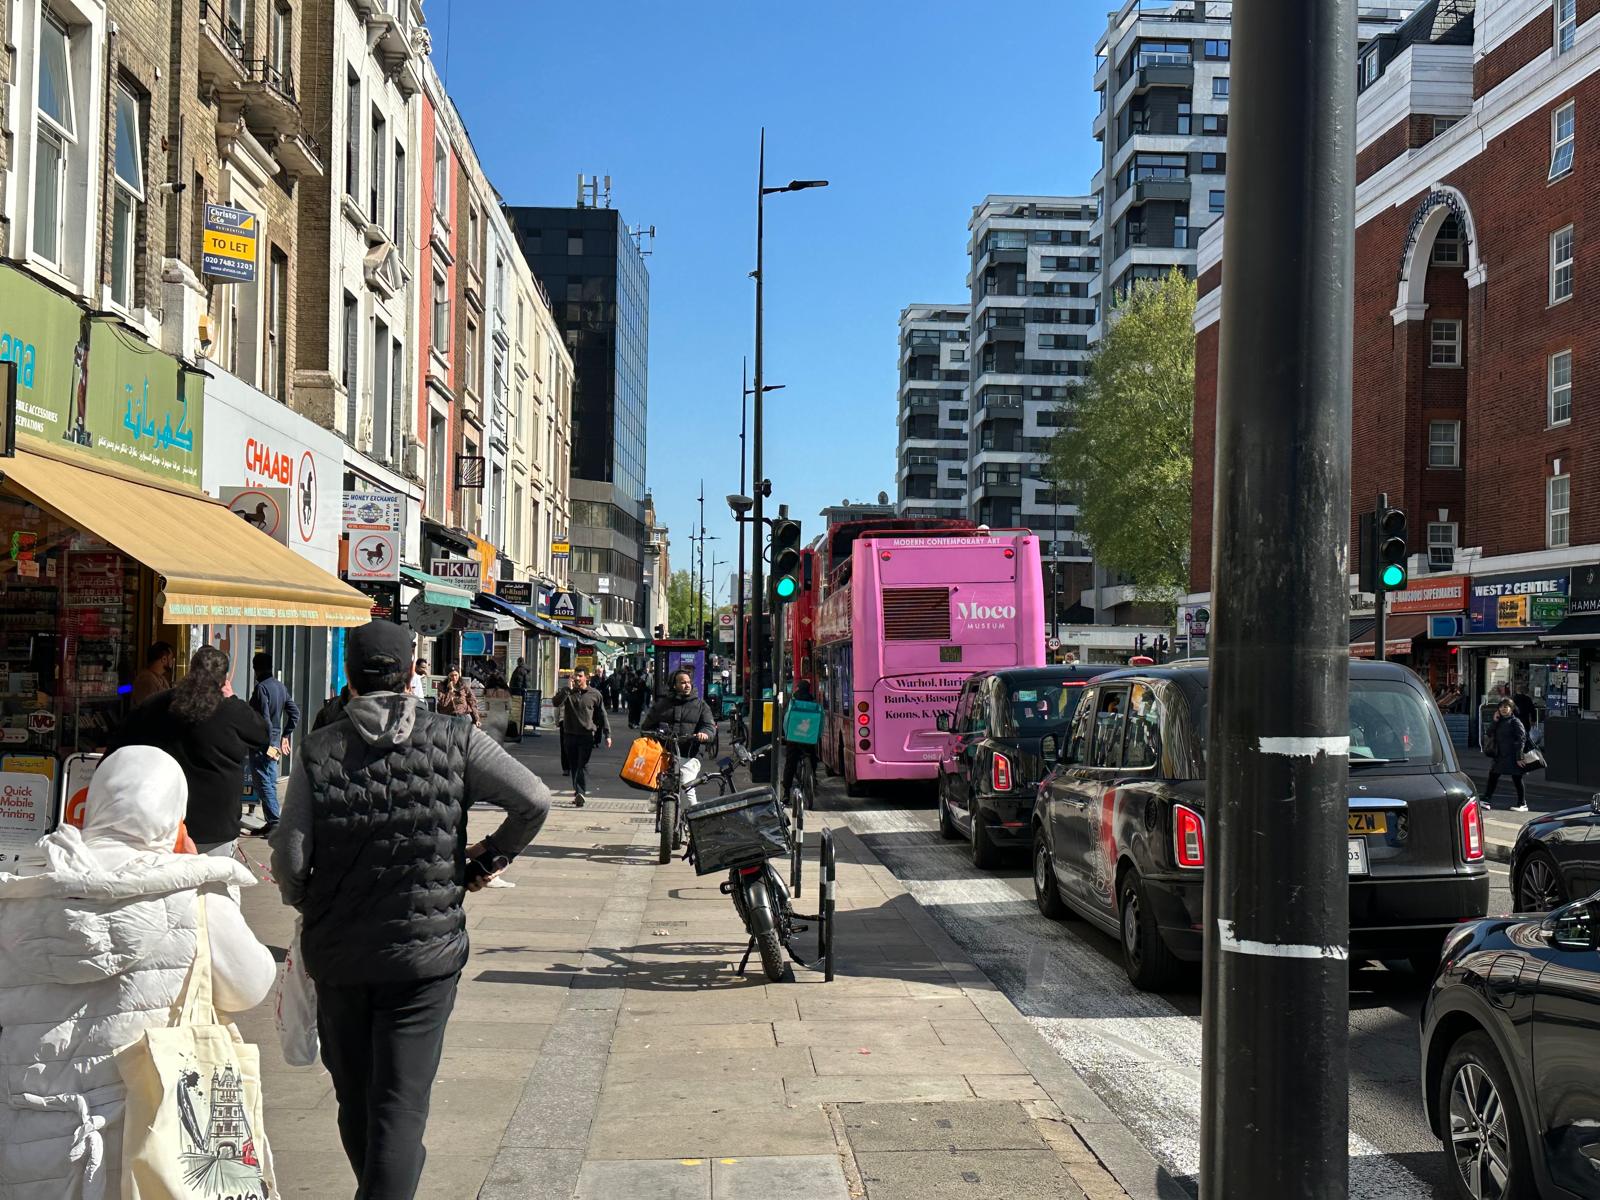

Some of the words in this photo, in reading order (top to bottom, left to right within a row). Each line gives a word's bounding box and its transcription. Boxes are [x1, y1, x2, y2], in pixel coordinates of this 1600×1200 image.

[210, 208, 237, 220] Christo
[212, 238, 226, 249] TO
[230, 241, 248, 253] LET
[205, 256, 218, 264] 020
[237, 262, 253, 271] 1203
[15, 414, 44, 432] SERVATIONS
[245, 437, 294, 487] CHAABI
[370, 495, 398, 503] EXCHANGE
[987, 537, 1000, 545] ART
[434, 562, 478, 577] TKM
[1475, 584, 1504, 596] WEST
[1505, 584, 1512, 595] 2
[1514, 579, 1558, 594] CENTRE
[956, 602, 1016, 620] Moco
[896, 677, 938, 688] Warhol,
[884, 694, 924, 705] Banksy,
[926, 694, 961, 704] Basqui
[885, 710, 921, 719] Koons,
[4, 785, 33, 797] Quick
[0, 796, 34, 807] Mobile
